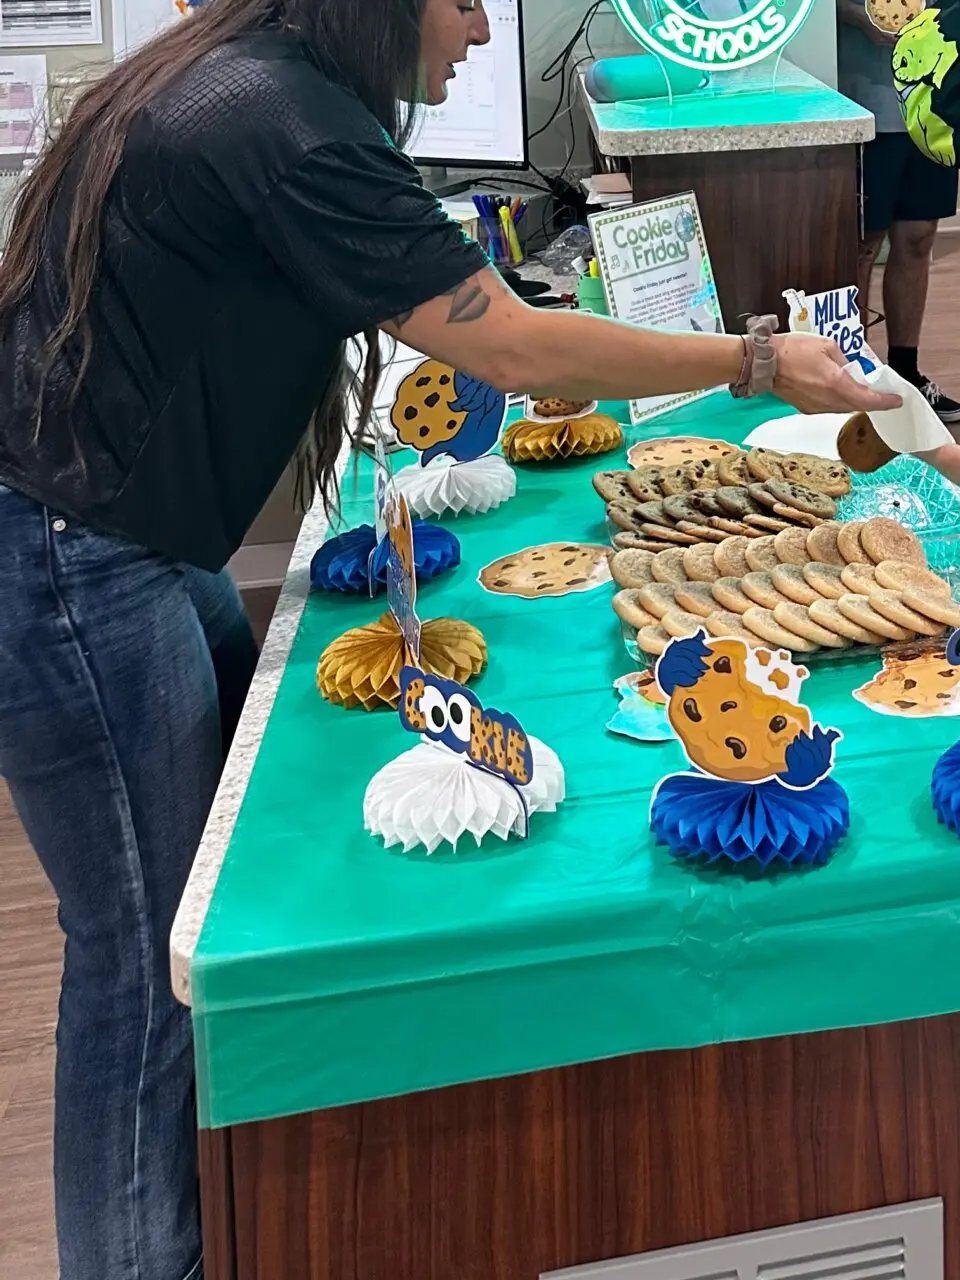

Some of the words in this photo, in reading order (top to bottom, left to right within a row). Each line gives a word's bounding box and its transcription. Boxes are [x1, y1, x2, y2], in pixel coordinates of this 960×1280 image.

[659, 6, 786, 61] SCHOOLS
[613, 216, 673, 248] Cookie
[632, 240, 690, 268] Friday
[814, 288, 858, 326] MILK
[405, 678, 528, 784] COOKIE
